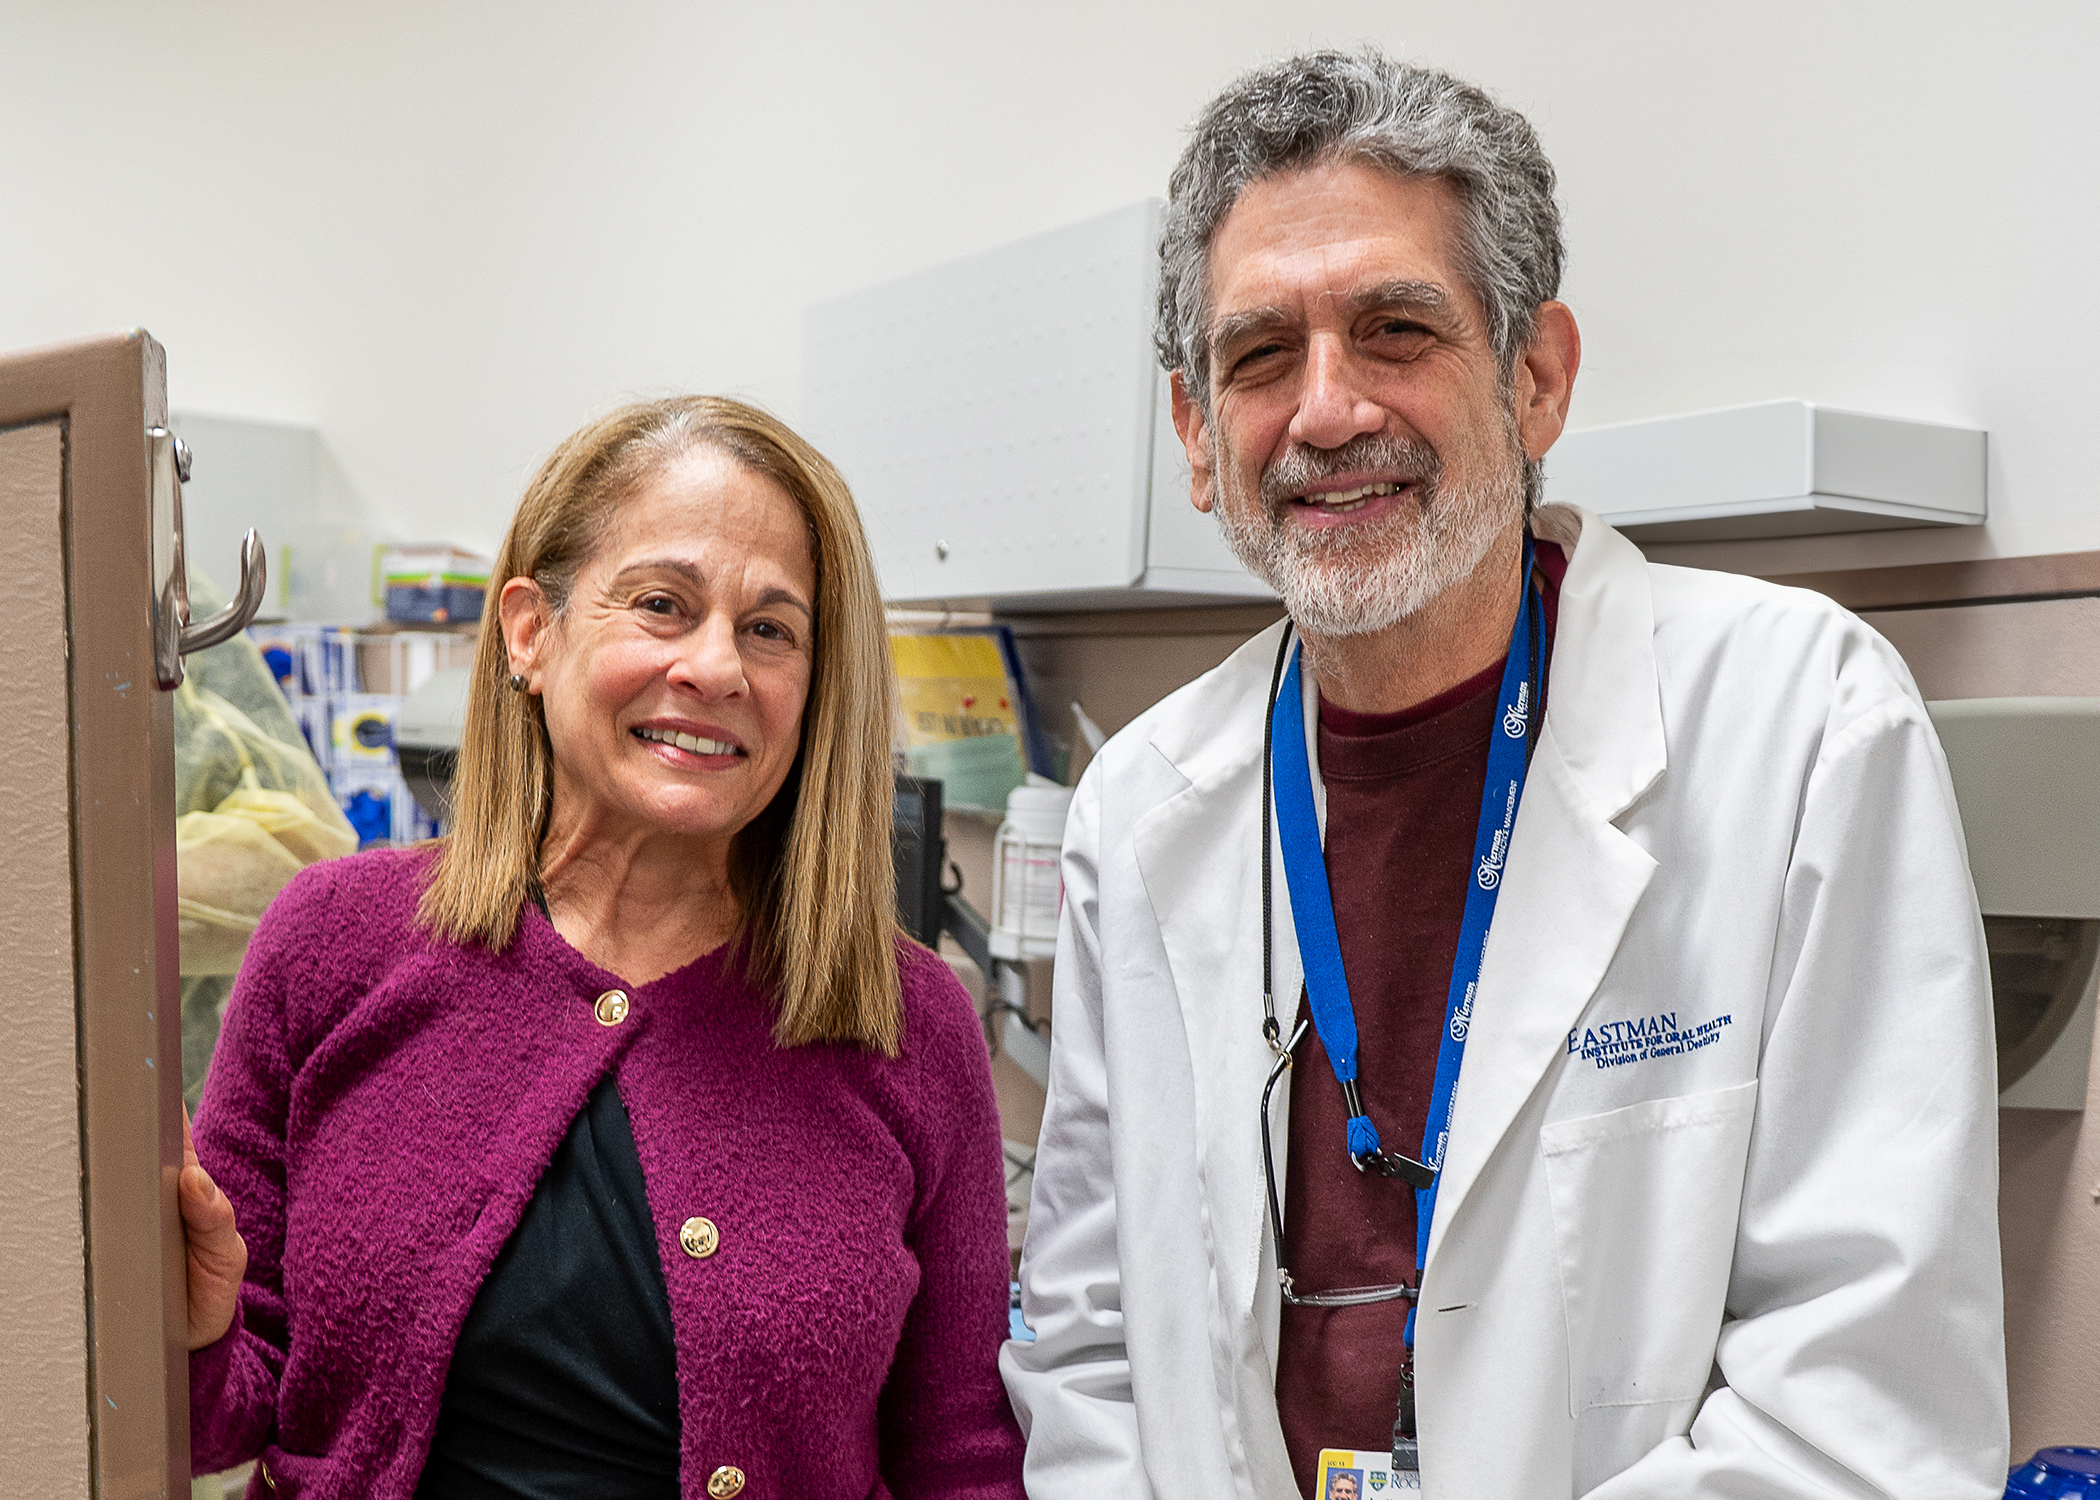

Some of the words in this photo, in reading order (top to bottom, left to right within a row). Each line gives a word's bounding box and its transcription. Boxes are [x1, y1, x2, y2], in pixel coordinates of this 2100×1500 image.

[1503, 681, 1529, 738] Nierman
[1503, 779, 1518, 829] MANAGEMENT
[1477, 828, 1503, 890] Nierman
[1450, 981, 1475, 1042] Nierman
[1567, 1012, 1677, 1055] EASTMAN
[1580, 1038, 1644, 1060] INSTITUTE
[1645, 1034, 1664, 1047] FOR
[1665, 1029, 1695, 1043] ORAL
[1696, 1014, 1732, 1036] HEALTH
[1596, 1053, 1638, 1069] Division
[1639, 1048, 1649, 1061] of
[1650, 1040, 1685, 1058] General
[1686, 1031, 1721, 1051] Dentistry
